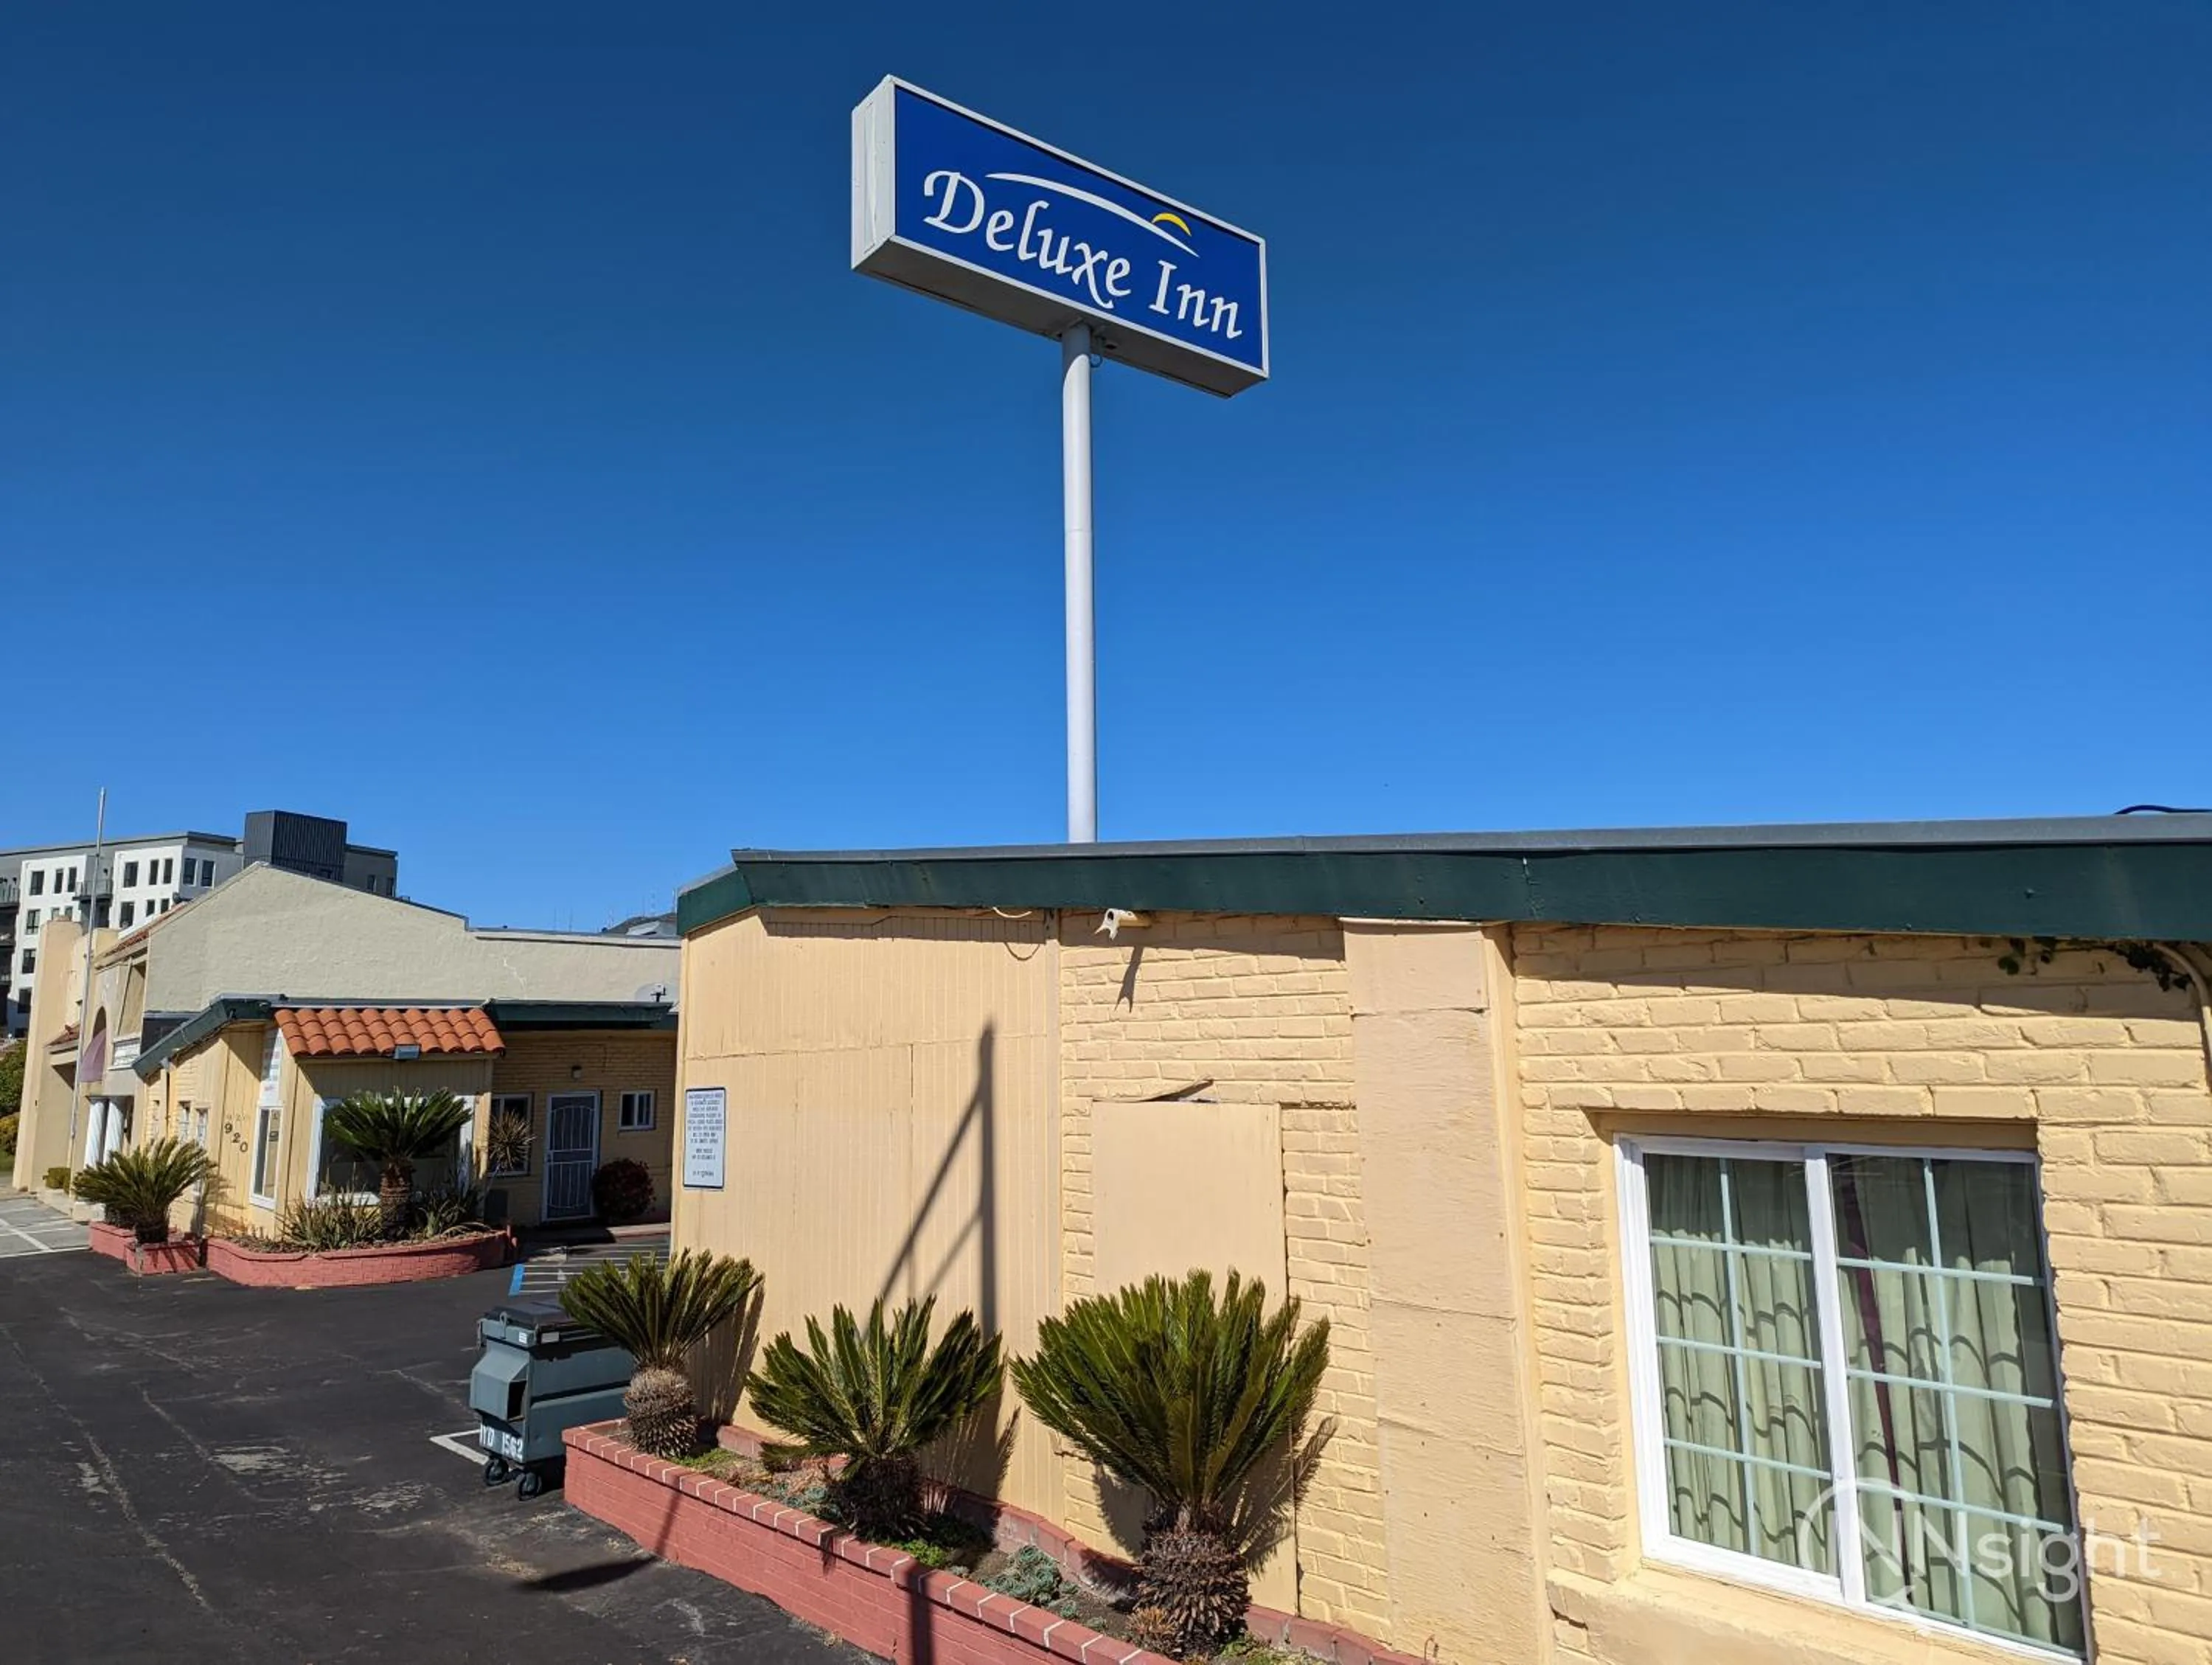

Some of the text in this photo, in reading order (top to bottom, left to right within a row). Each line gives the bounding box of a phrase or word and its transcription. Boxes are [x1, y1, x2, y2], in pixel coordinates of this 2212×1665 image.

[923, 170, 1242, 340] Deluxe Inn
[224, 1121, 248, 1153] 920
[502, 1432, 524, 1463] 1562
